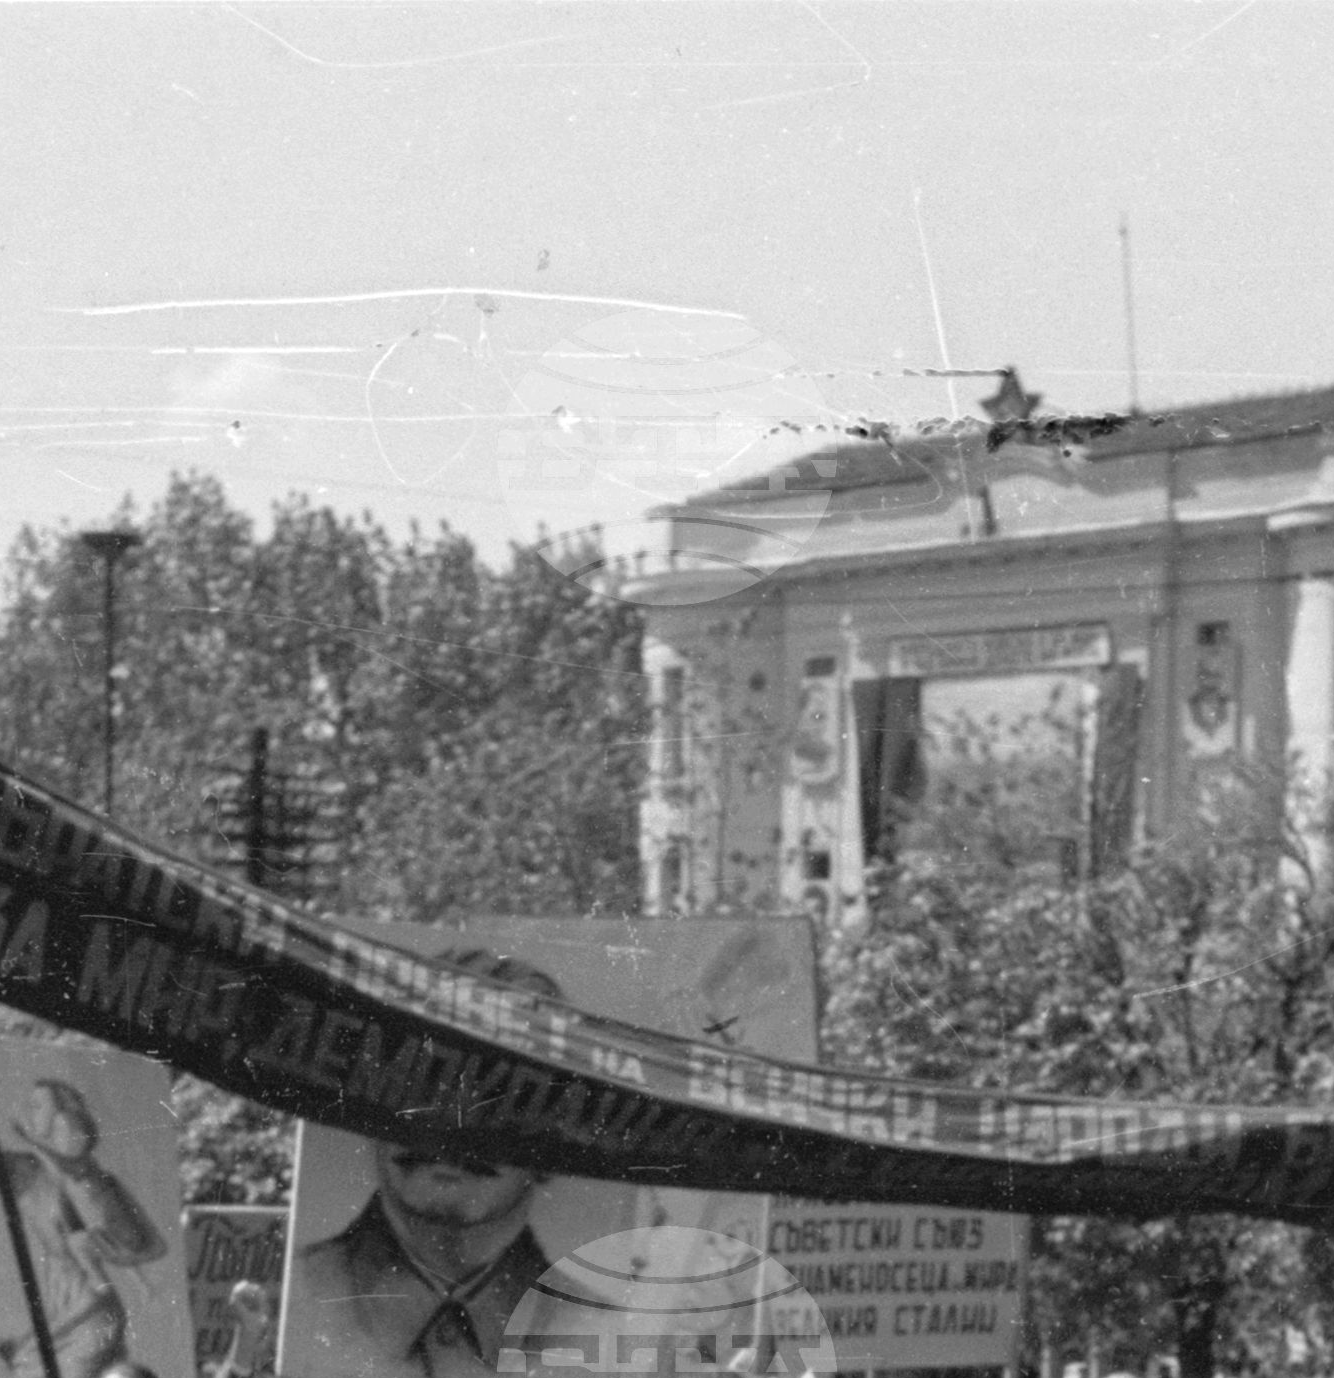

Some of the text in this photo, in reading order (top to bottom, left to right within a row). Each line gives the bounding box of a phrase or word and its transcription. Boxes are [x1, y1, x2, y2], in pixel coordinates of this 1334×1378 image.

[767, 1217, 984, 1255] СЪВЕТСКИ СЪЮЗ
[894, 1303, 998, 1337] СТАЛИН
